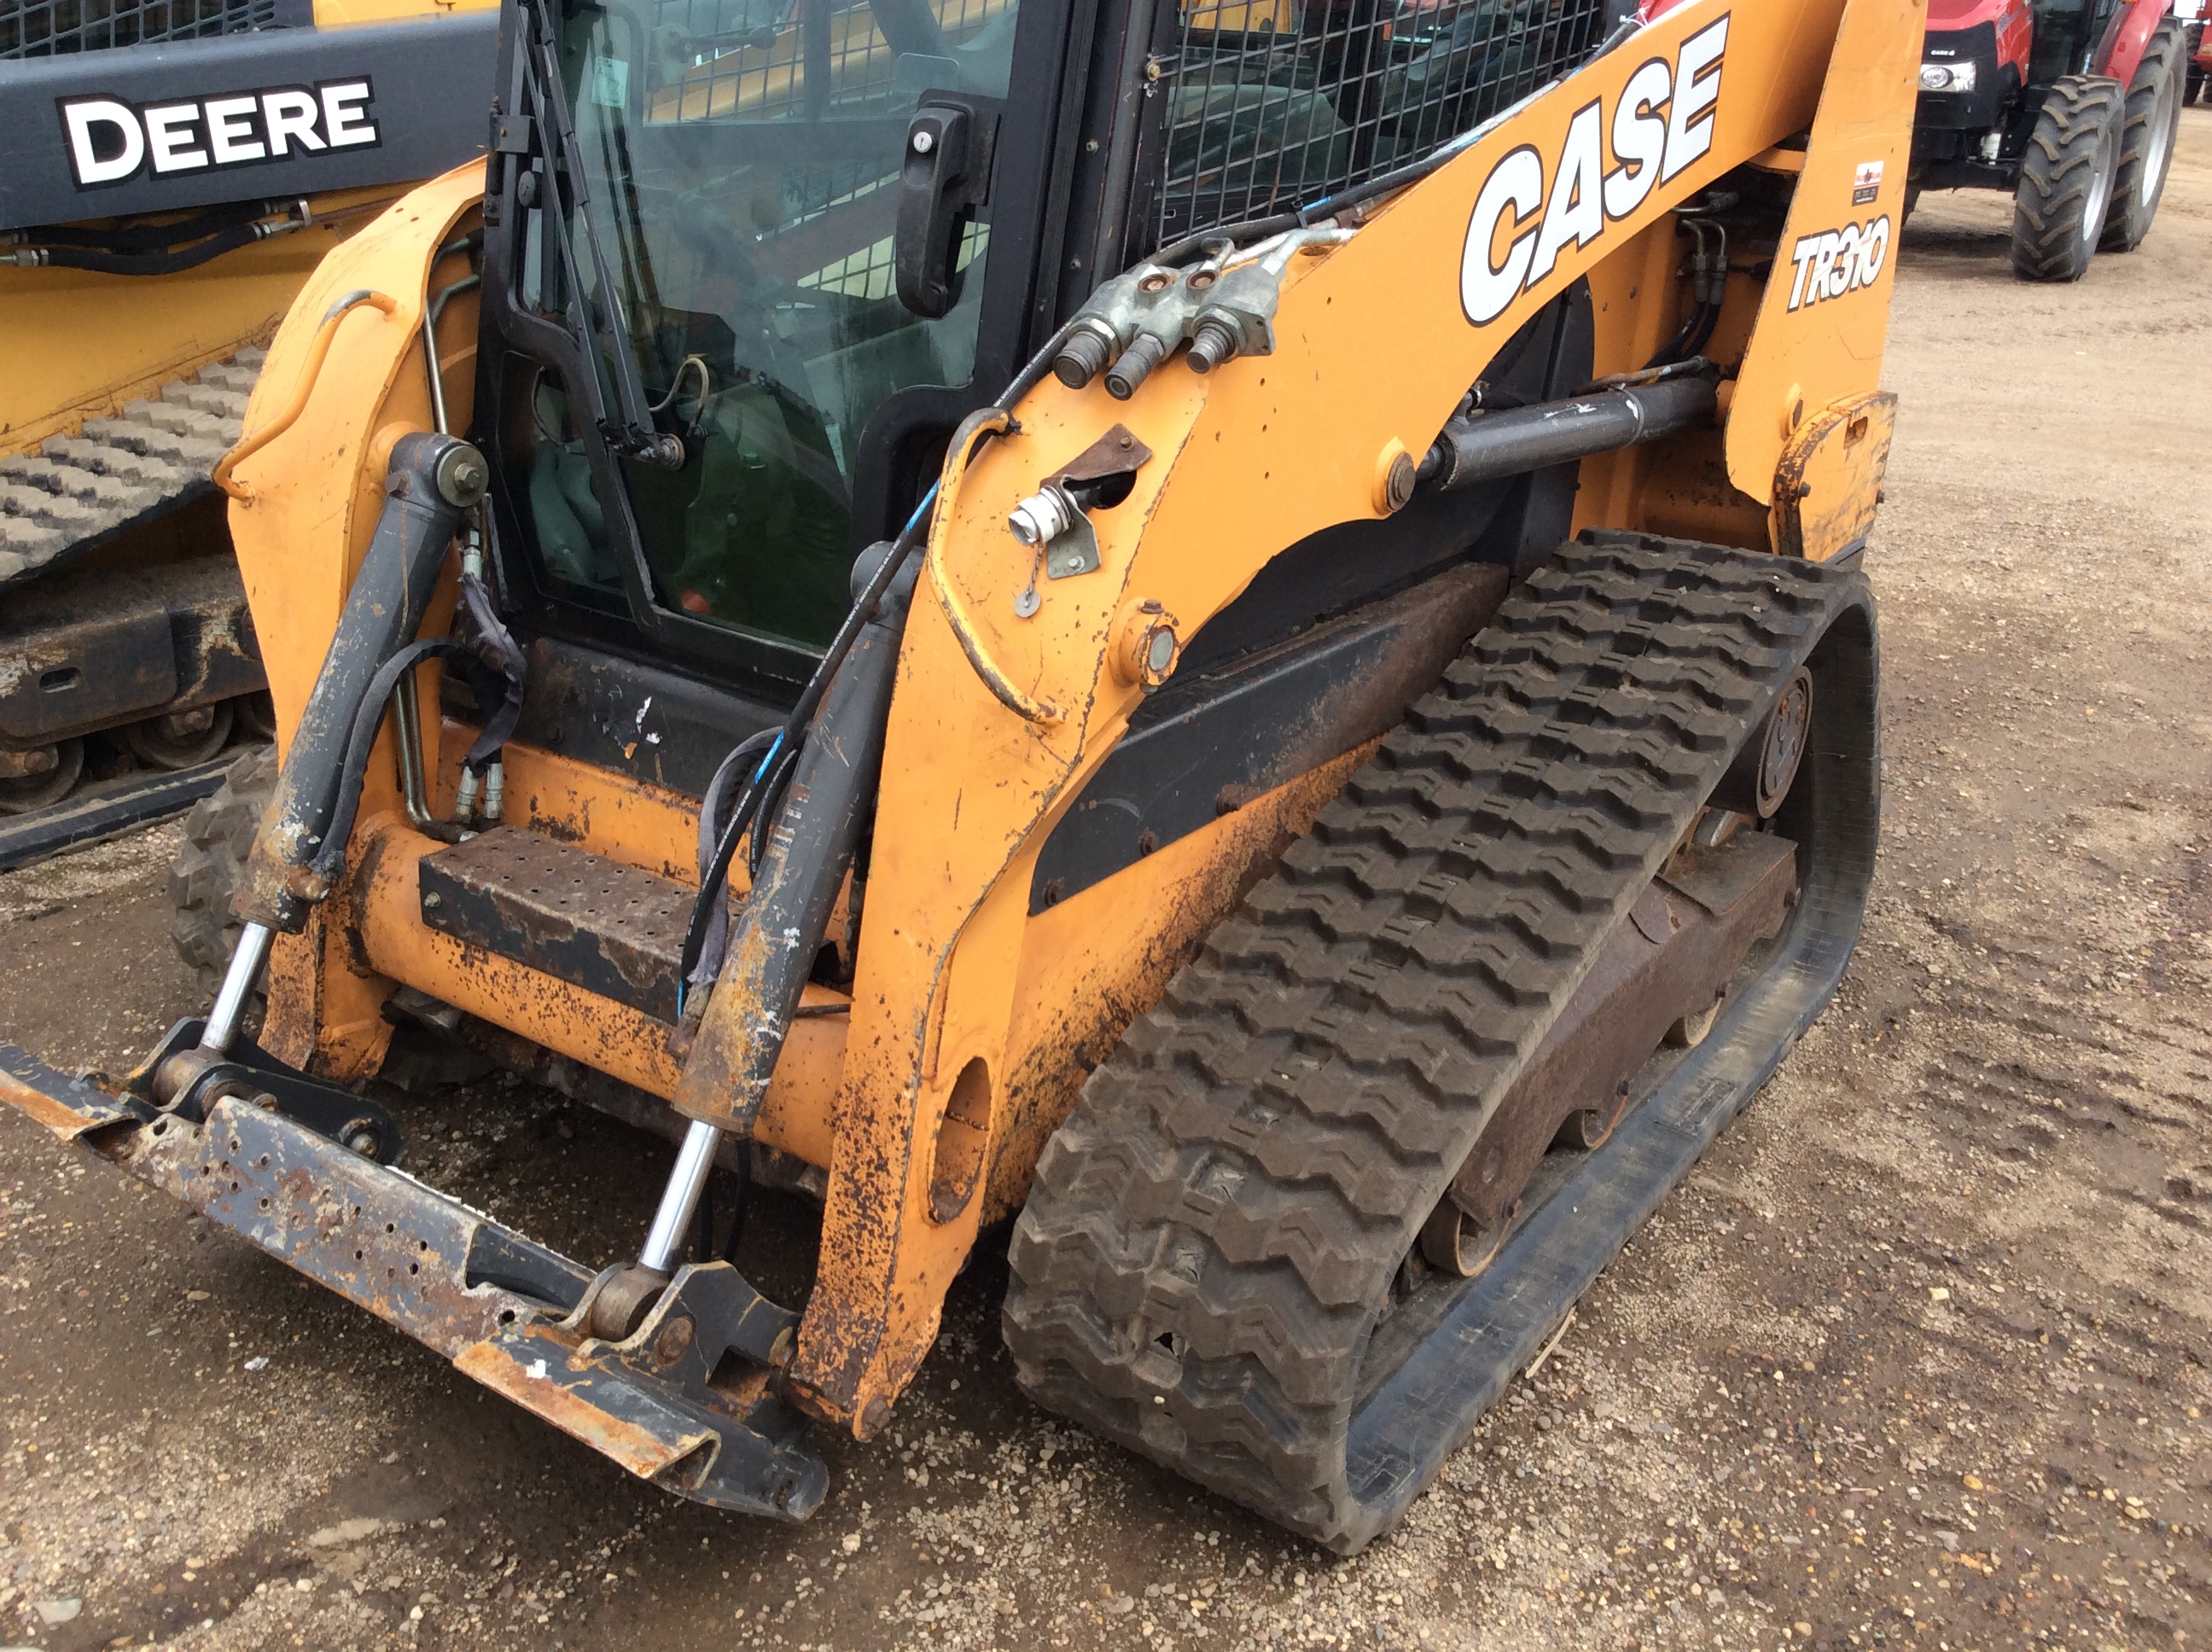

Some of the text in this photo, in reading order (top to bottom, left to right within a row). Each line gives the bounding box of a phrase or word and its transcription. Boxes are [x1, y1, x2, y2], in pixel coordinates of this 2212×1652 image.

[64, 80, 378, 186] DEERE
[1461, 14, 1731, 326] CASE
[1787, 215, 1889, 312] TR310
